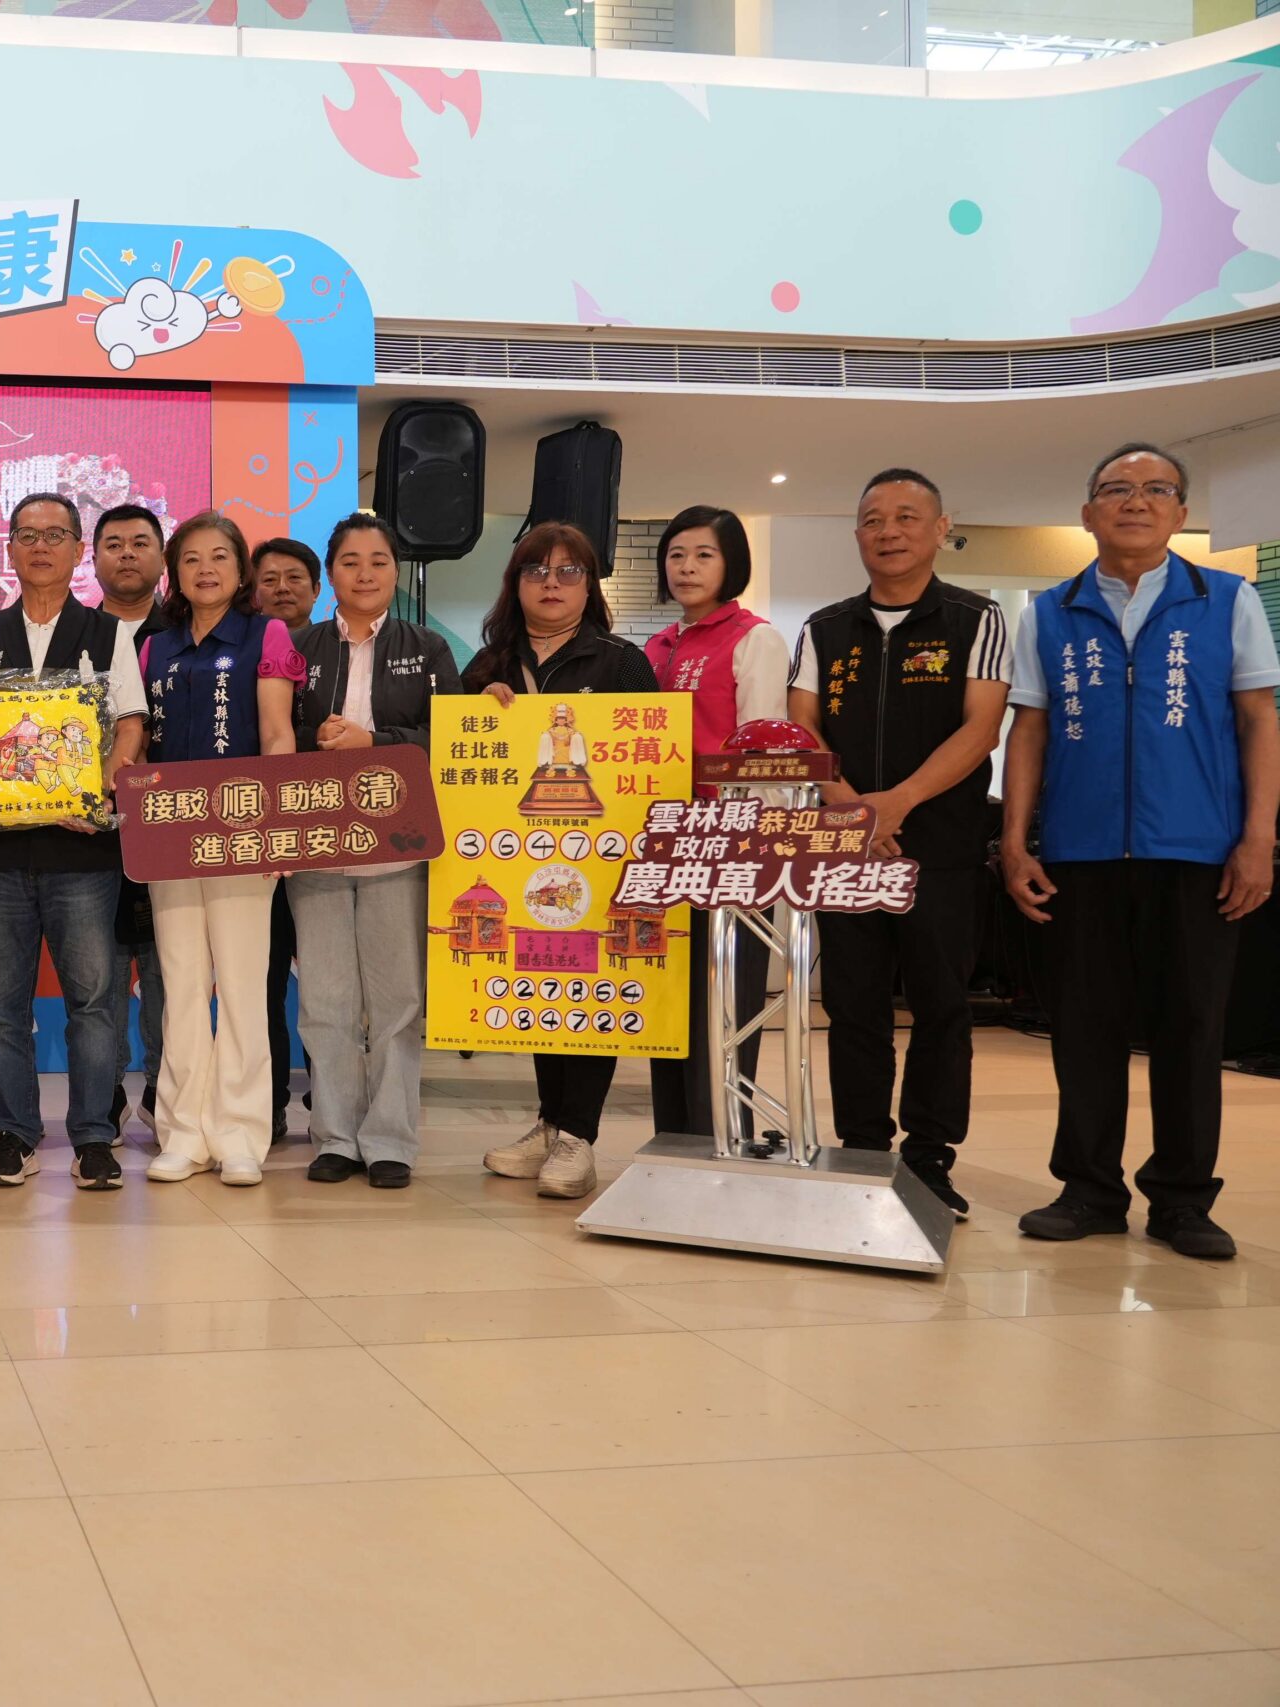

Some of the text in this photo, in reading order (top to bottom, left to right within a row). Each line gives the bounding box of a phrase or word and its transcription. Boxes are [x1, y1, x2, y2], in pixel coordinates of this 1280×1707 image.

[391, 665, 422, 676] YUNLIN
[1085, 637, 1105, 686] 民政處
[166, 662, 181, 691] 議員
[307, 664, 322, 692] 議員
[1163, 629, 1190, 728] 雲林縣政府
[213, 671, 230, 755] 雲林縣議會
[460, 715, 499, 733] 徒步
[612, 706, 668, 732] 突破
[450, 741, 509, 760] 往北港
[591, 737, 686, 765] 35萬人
[440, 767, 519, 786] 進香報名
[615, 774, 661, 796] 以上
[647, 800, 761, 834] 雲林縣
[758, 810, 820, 837] 恭迎
[193, 823, 378, 867] 進香更安心
[671, 835, 730, 861] 政府
[806, 829, 867, 854] 聖駕
[615, 861, 914, 908] 慶典萬人搖獎
[472, 978, 479, 993] 1
[470, 1009, 479, 1022] 2
